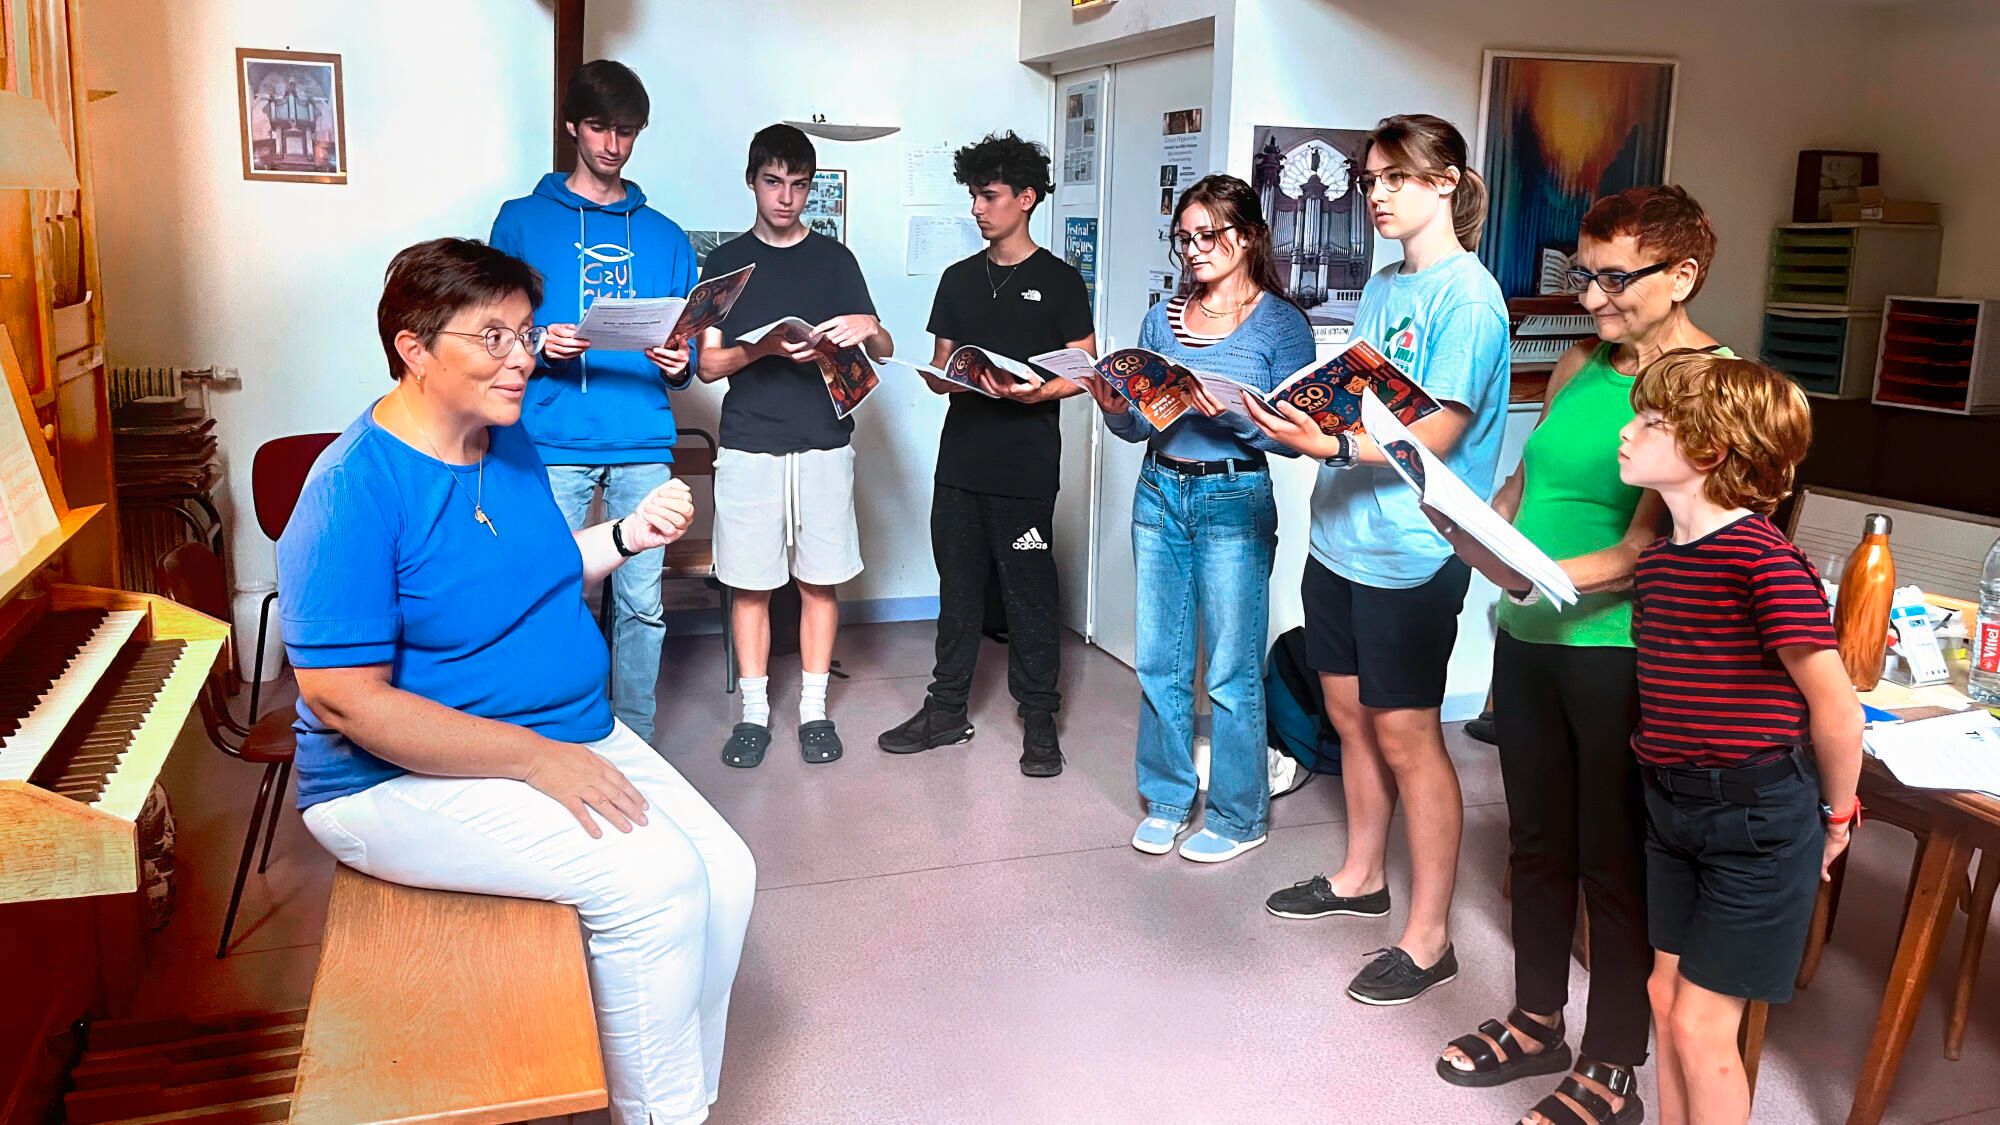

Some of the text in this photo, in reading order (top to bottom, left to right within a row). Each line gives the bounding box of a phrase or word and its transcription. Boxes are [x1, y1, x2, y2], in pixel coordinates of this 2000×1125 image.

[1115, 355, 1140, 371] 60
[1293, 386, 1324, 407] 60
[1307, 397, 1329, 412] ANS
[1012, 540, 1048, 550] adidas
[1983, 628, 1999, 658] Vittel
